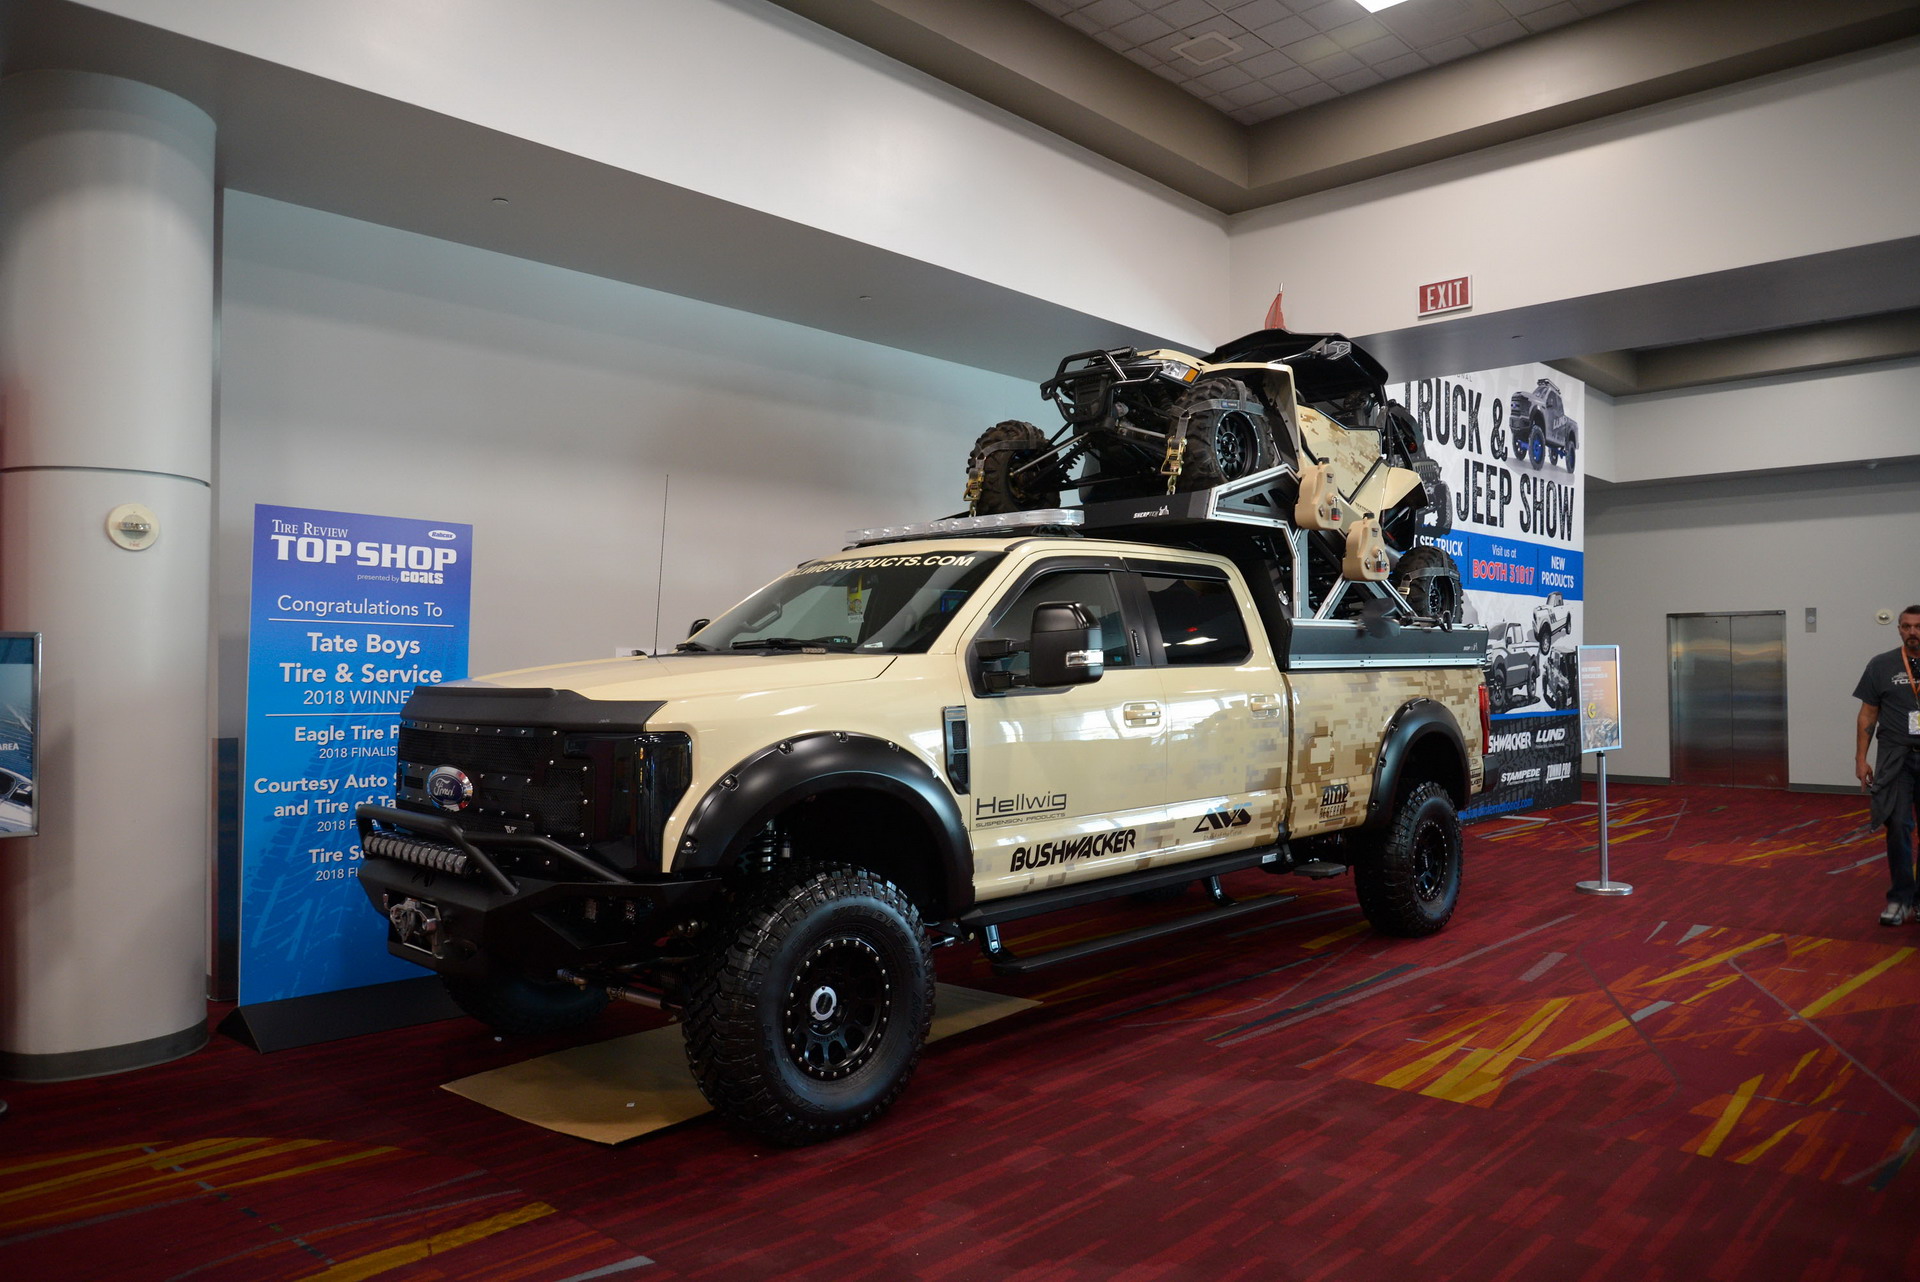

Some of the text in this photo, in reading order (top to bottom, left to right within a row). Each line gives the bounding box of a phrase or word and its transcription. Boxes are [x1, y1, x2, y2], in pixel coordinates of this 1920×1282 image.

[1427, 280, 1463, 311] EXIT
[1490, 398, 1508, 462] &
[1456, 458, 1575, 542] JEEP SHOW
[270, 534, 458, 572] TOP SHOP
[1436, 537, 1463, 557] TRUCK
[1492, 544, 1517, 559] Visit us at
[1472, 558, 1508, 582] BOOTH
[1551, 555, 1566, 571] NEW
[357, 573, 391, 583] presented
[391, 575, 400, 584] by
[1541, 571, 1574, 589] PRODUCTS
[277, 595, 443, 617] Congratulations To
[307, 632, 421, 659] Tate Boys
[279, 662, 443, 684] Tire & Service
[303, 690, 415, 705] 2018 WINNE
[295, 725, 345, 746] Eagle
[351, 726, 384, 740] Tire
[1535, 728, 1566, 743] LUND
[319, 746, 398, 759] 2018 FINALIS
[254, 777, 339, 795] Courtesy
[344, 774, 388, 789] Auto
[1500, 768, 1541, 784] STAMPEDE
[274, 799, 309, 817] and
[314, 800, 349, 814] Tire
[976, 791, 1067, 815] Hellwig
[317, 820, 346, 832] 2018
[1026, 812, 1066, 822] PRODUCTS
[308, 848, 344, 864] Tire
[1010, 829, 1137, 872] BUSHWACKER
[315, 869, 345, 882] 2018
